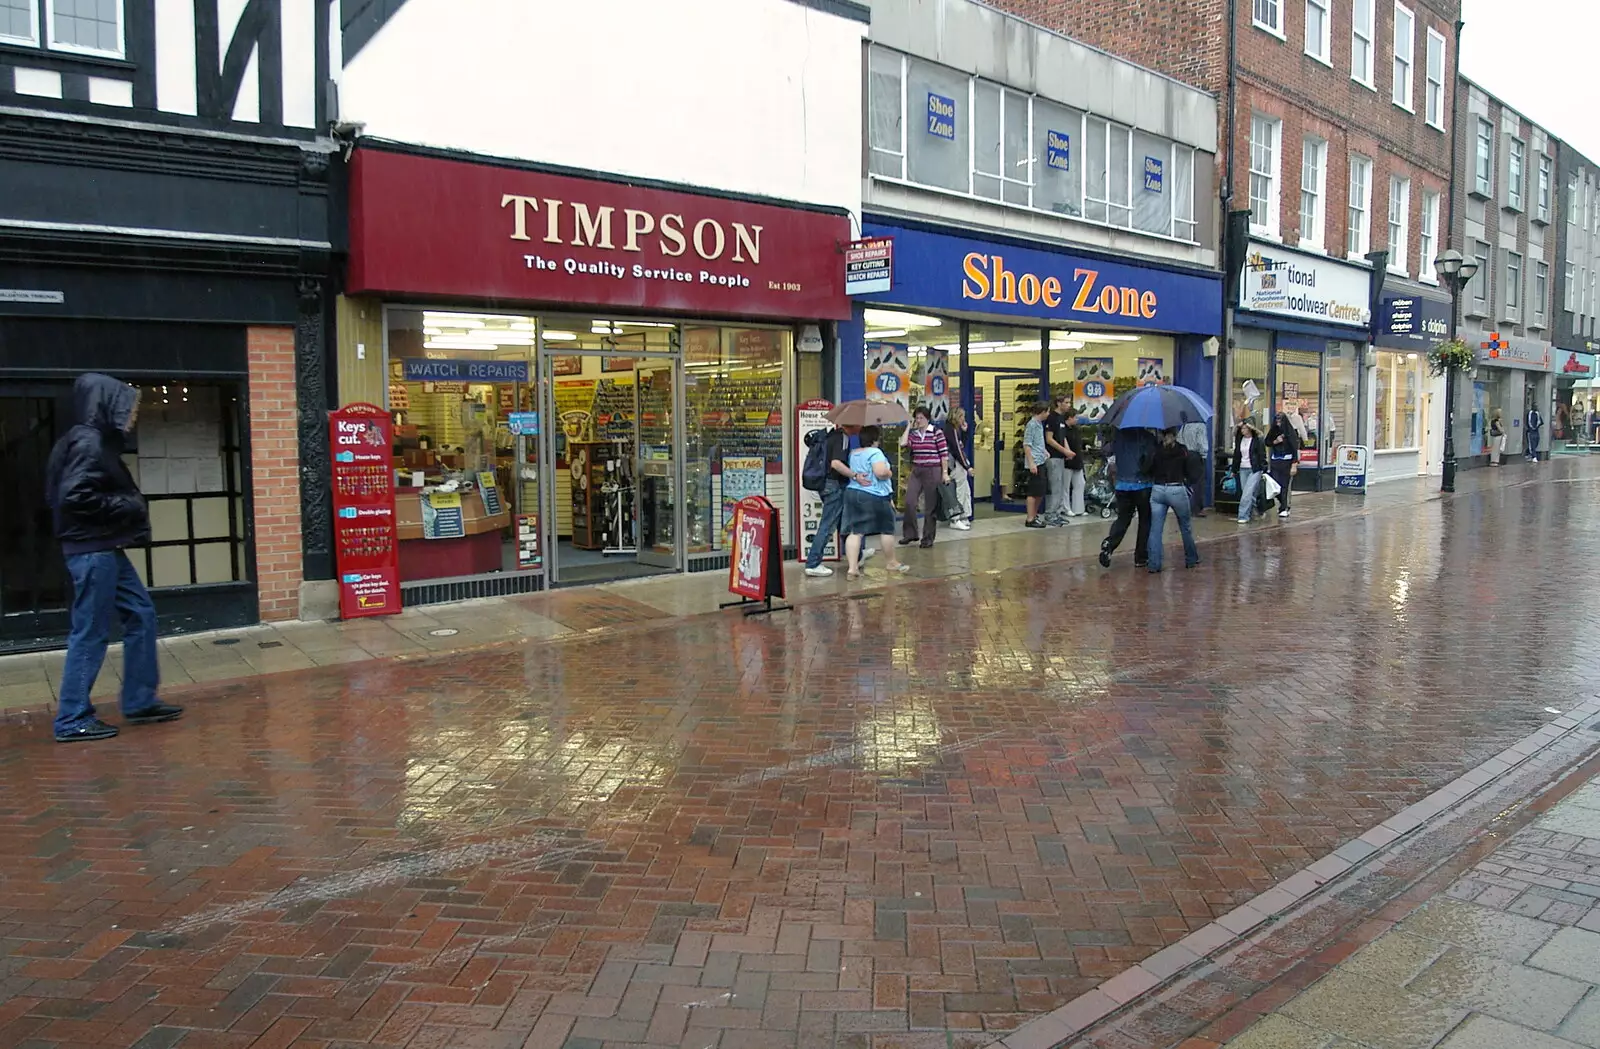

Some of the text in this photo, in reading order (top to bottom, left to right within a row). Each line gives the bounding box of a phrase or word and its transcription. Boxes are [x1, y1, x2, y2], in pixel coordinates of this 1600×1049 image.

[929, 96, 953, 117] Shoe
[929, 115, 953, 137] Zone
[1048, 133, 1068, 151] Shoe
[1048, 150, 1068, 169] Zone
[1145, 158, 1161, 175] Shoe
[1145, 174, 1161, 192] Zone
[501, 194, 763, 264] TIMPSON
[851, 249, 886, 260] SHOE REPAIRS
[524, 255, 750, 288] The Quality Service People
[863, 260, 885, 269] CUTTING
[848, 270, 888, 281] WATCH REPAIRS
[768, 281, 801, 291] Est 1903
[962, 252, 1157, 319] Shoe Zone
[1253, 301, 1284, 309] Centres
[1329, 300, 1361, 321] Centres
[1428, 318, 1447, 336] dolphin
[409, 363, 526, 378] WATCH REPAIRS
[880, 374, 896, 391] 7.99
[346, 405, 376, 414] TIMPSON
[801, 411, 818, 419] House
[338, 421, 366, 435] Keys
[338, 436, 361, 445] cut.
[724, 460, 762, 469] PET TAGS
[804, 503, 811, 518] 3
[743, 514, 765, 528] Engraving
